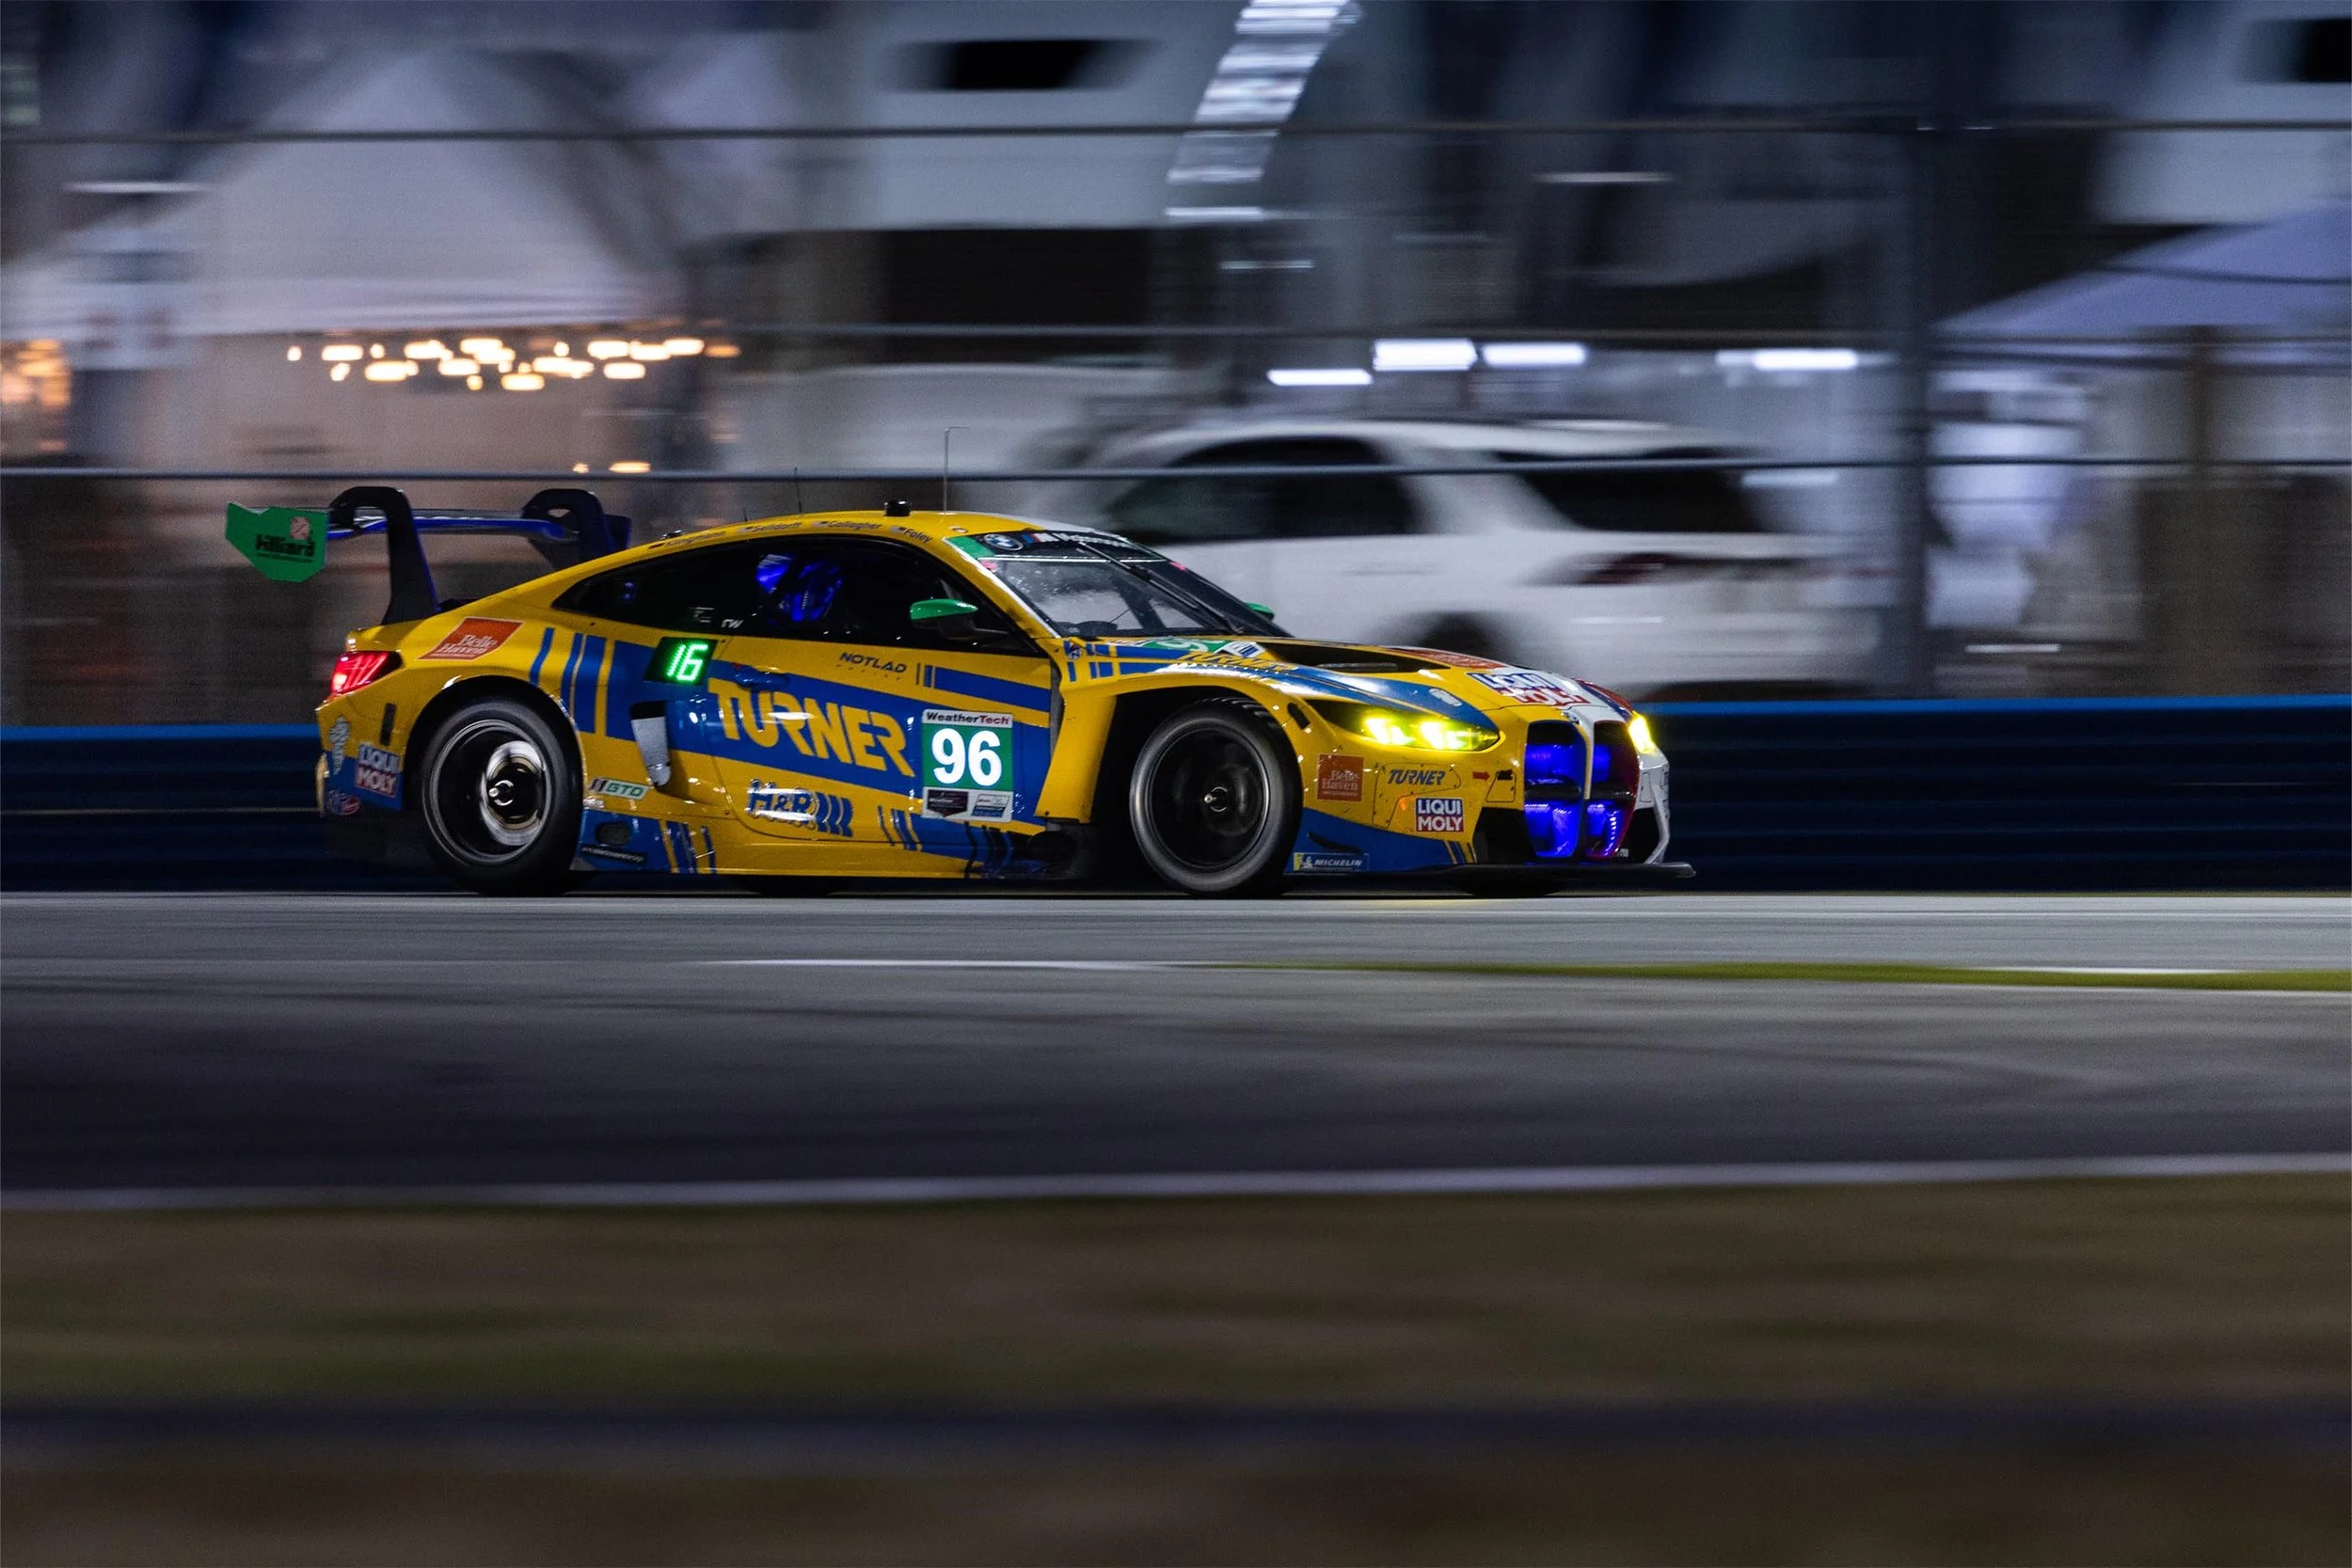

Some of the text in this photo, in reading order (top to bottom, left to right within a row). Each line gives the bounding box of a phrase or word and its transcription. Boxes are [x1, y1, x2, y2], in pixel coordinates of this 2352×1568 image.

[903, 527, 932, 543] Foley
[666, 643, 708, 681] 16
[839, 652, 907, 673] NOTLAD
[707, 676, 915, 777] TURNER
[926, 712, 1009, 725] WeatherTech
[931, 727, 1003, 786] 96
[1388, 768, 1446, 785] TURNER
[1418, 816, 1463, 832] MOLY
